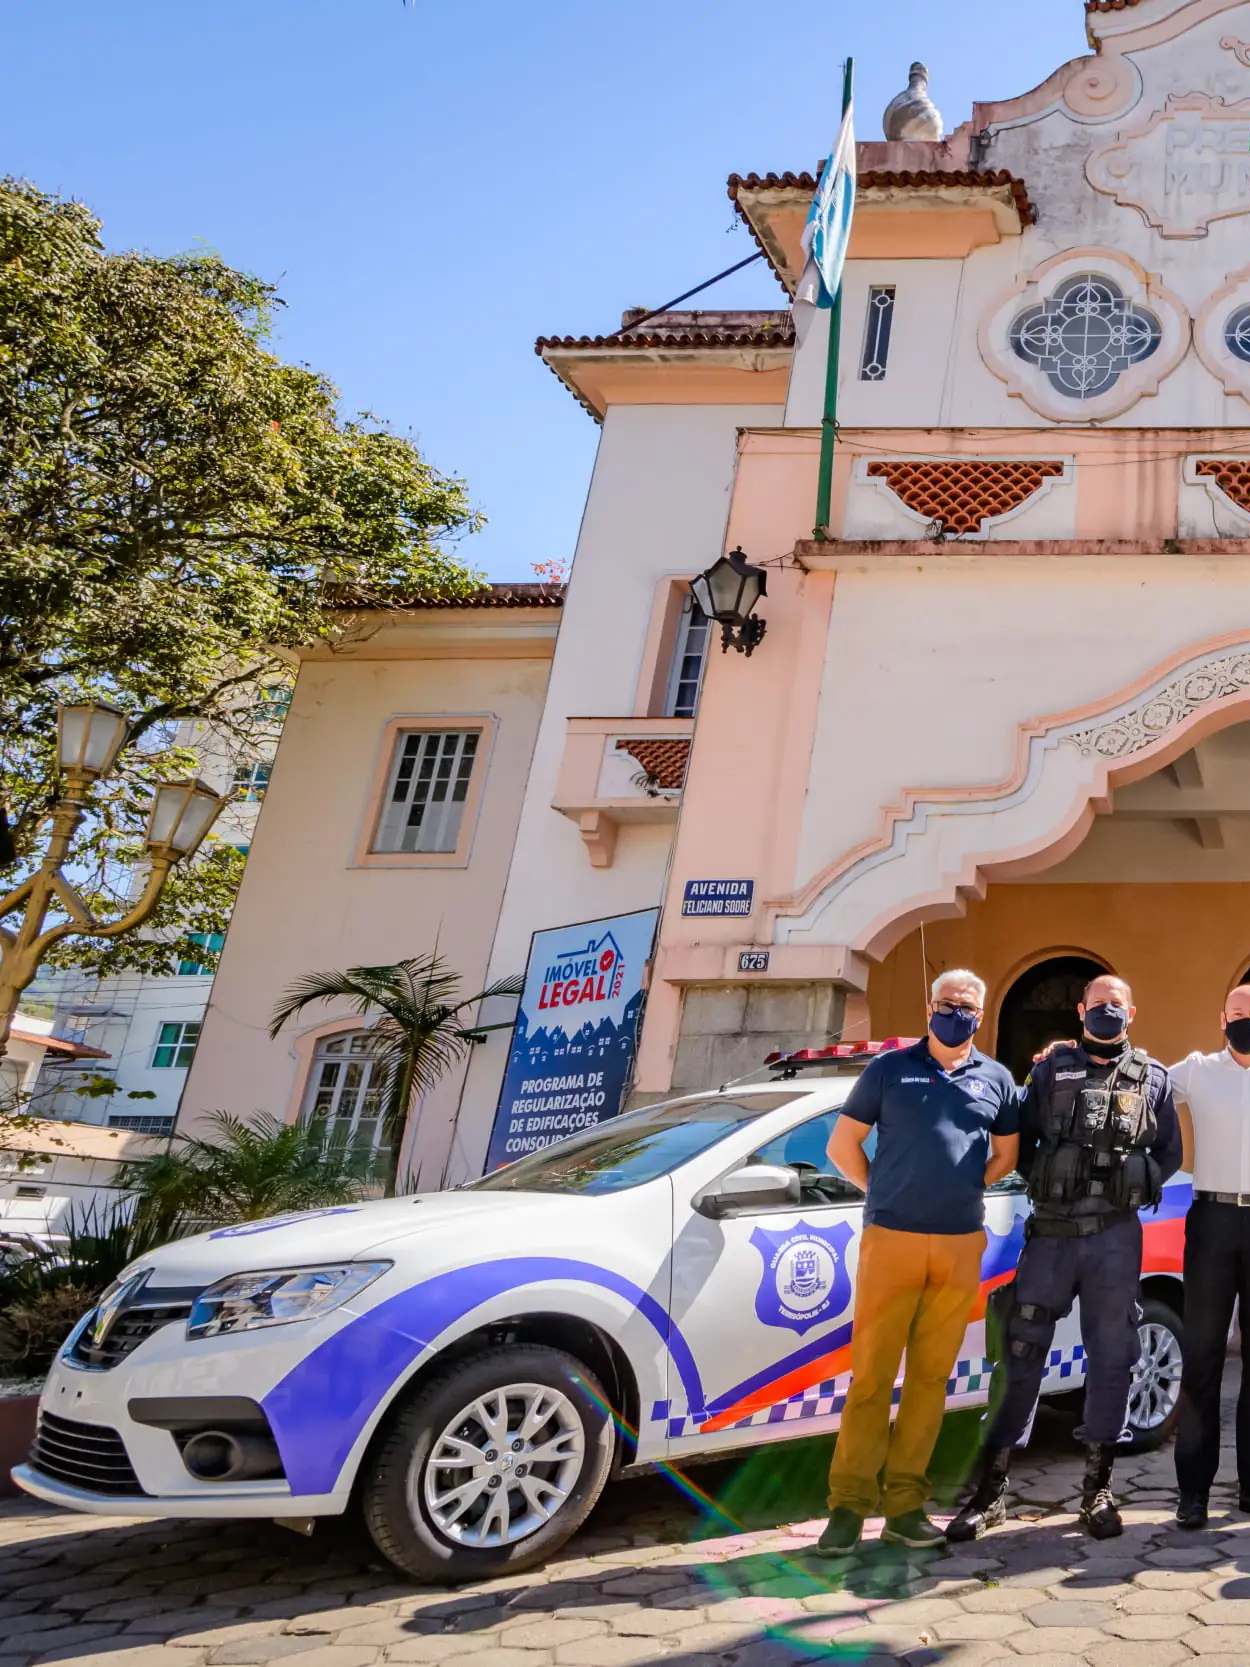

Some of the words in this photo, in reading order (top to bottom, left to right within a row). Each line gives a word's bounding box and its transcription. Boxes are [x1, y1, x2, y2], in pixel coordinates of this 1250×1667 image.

[690, 882, 748, 895] AVENIDA
[682, 900, 722, 914] FELICIANO
[544, 958, 598, 983] IMÓVEL
[612, 963, 626, 999] 2021
[537, 975, 606, 1010] LEGAL
[520, 1074, 584, 1095] PROGRAMA
[587, 1071, 604, 1088] DE
[511, 1088, 606, 1114] REGULARIZAÇÃO
[509, 1118, 525, 1134] DE
[525, 1110, 599, 1132] EDIFICAÇÕES
[791, 1233, 809, 1243] CIVIL
